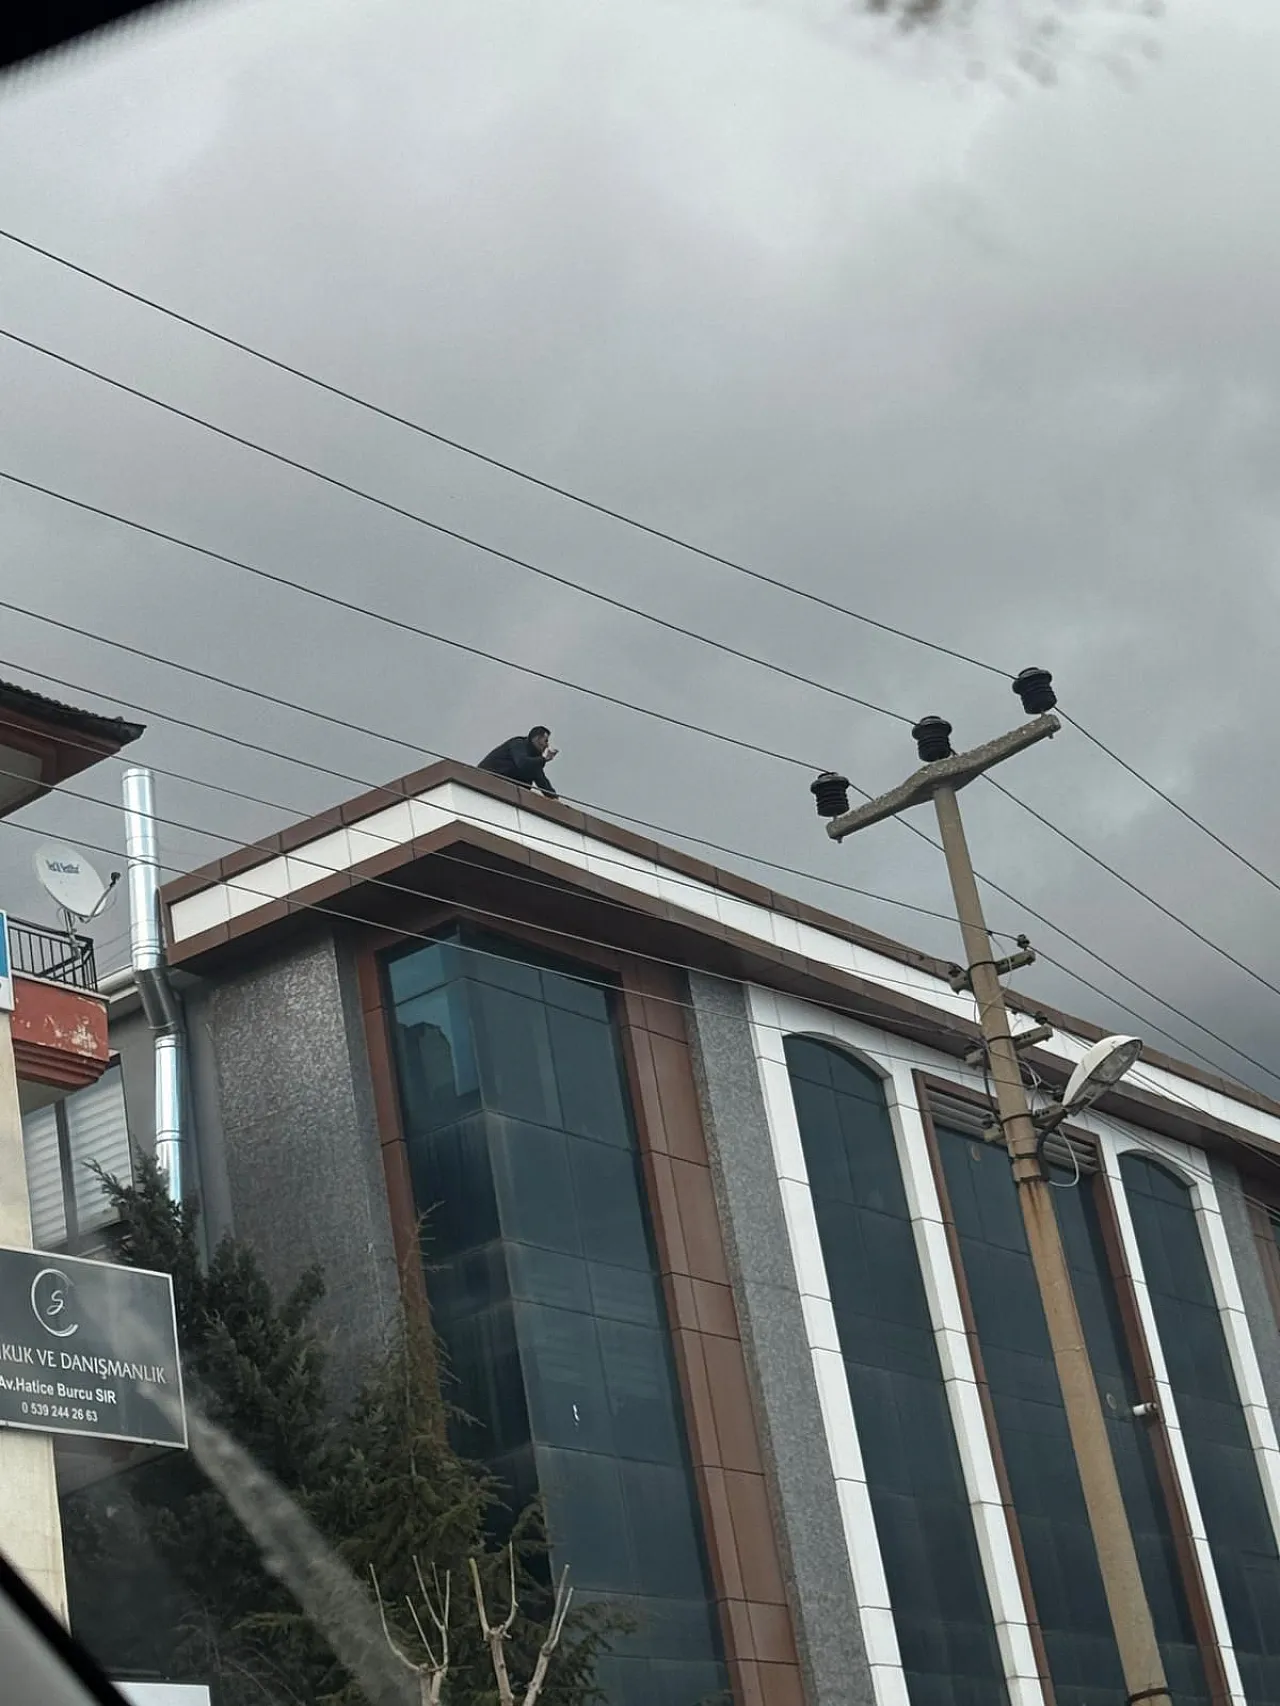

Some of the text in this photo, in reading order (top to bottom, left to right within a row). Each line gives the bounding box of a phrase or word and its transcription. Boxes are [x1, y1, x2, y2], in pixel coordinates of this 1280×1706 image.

[0, 1343, 167, 1384] KUK VE DANIŞMANLIK
[57, 1382, 93, 1401] Burcu
[95, 1388, 117, 1404] SIR
[30, 1402, 49, 1417] 539
[51, 1405, 70, 1419] 244
